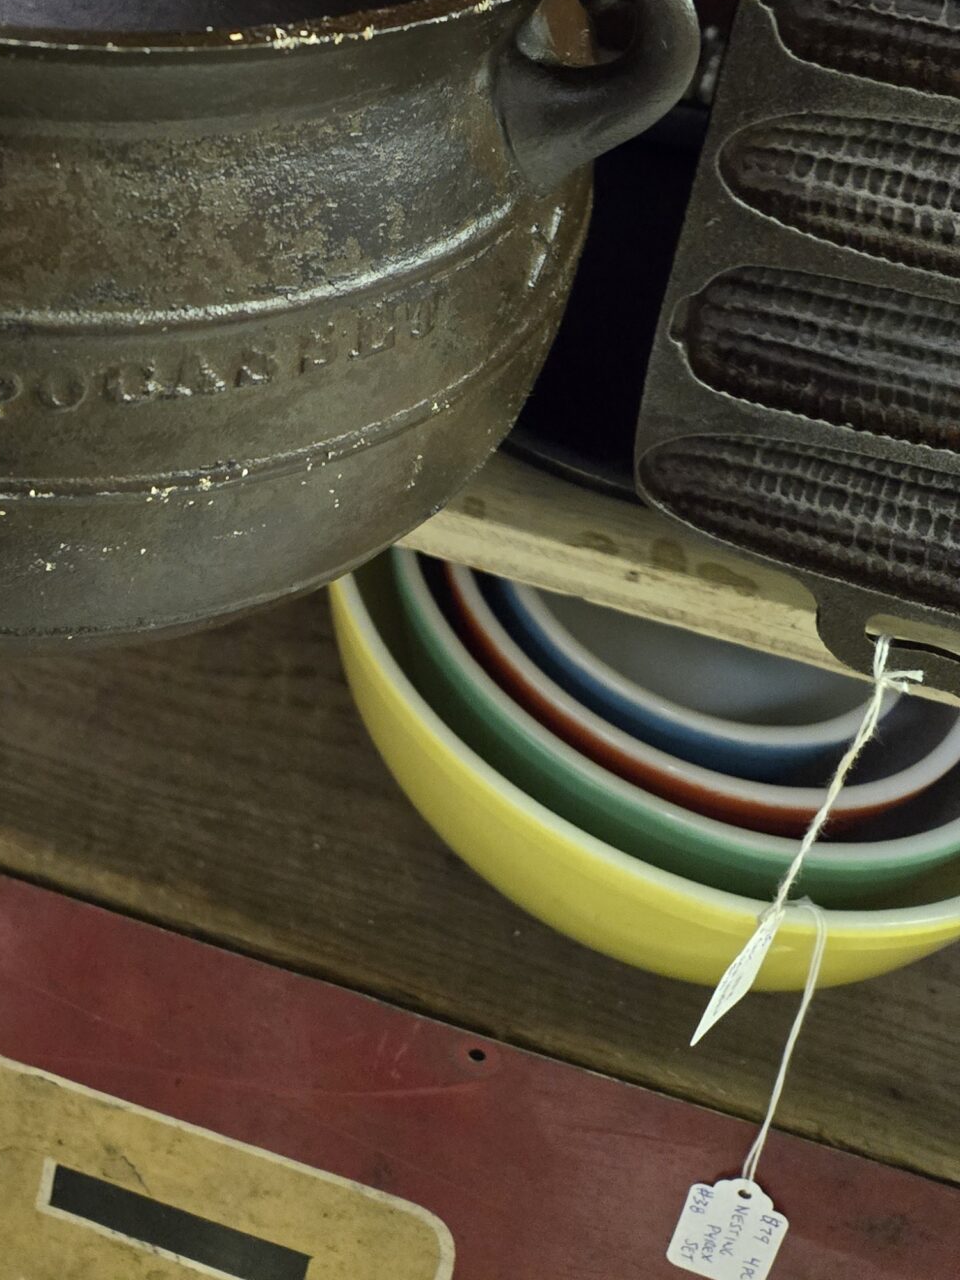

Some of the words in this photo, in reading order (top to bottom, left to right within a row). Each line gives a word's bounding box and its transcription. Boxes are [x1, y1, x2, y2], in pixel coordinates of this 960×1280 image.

[689, 1187, 715, 1214] #38
[701, 1223, 722, 1263] PYREX
[719, 1204, 751, 1257] NESTING
[680, 1238, 699, 1263] SET
